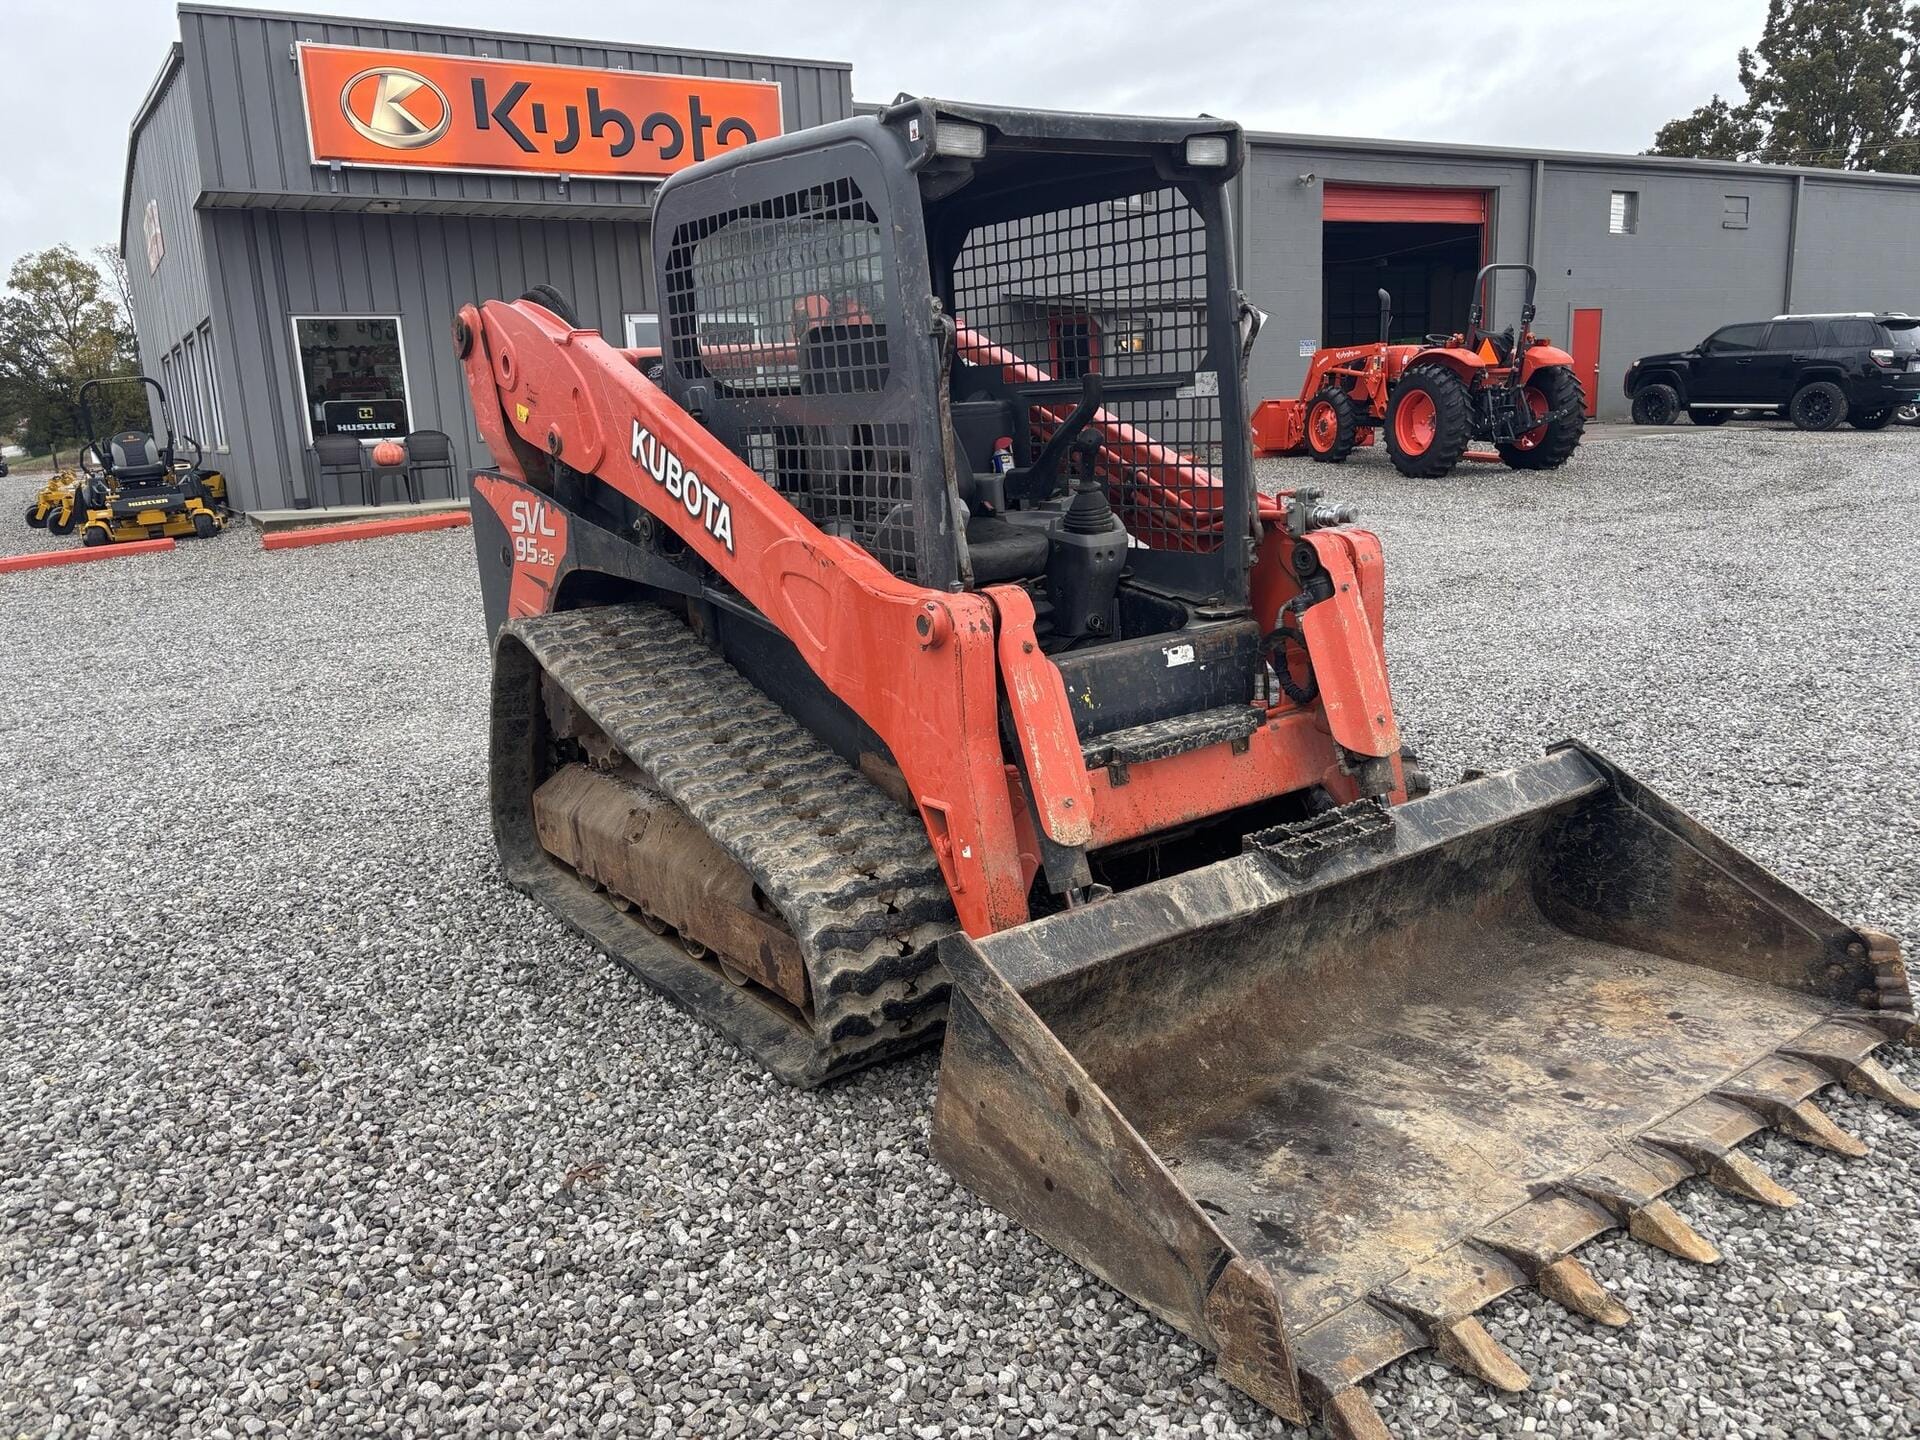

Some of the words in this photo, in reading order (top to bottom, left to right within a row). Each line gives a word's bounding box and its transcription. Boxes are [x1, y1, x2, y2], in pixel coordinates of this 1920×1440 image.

[336, 422, 397, 432] HUSTLER
[631, 418, 734, 552] KUBOTA
[128, 498, 169, 507] HUSTLER
[511, 500, 556, 537] SVL
